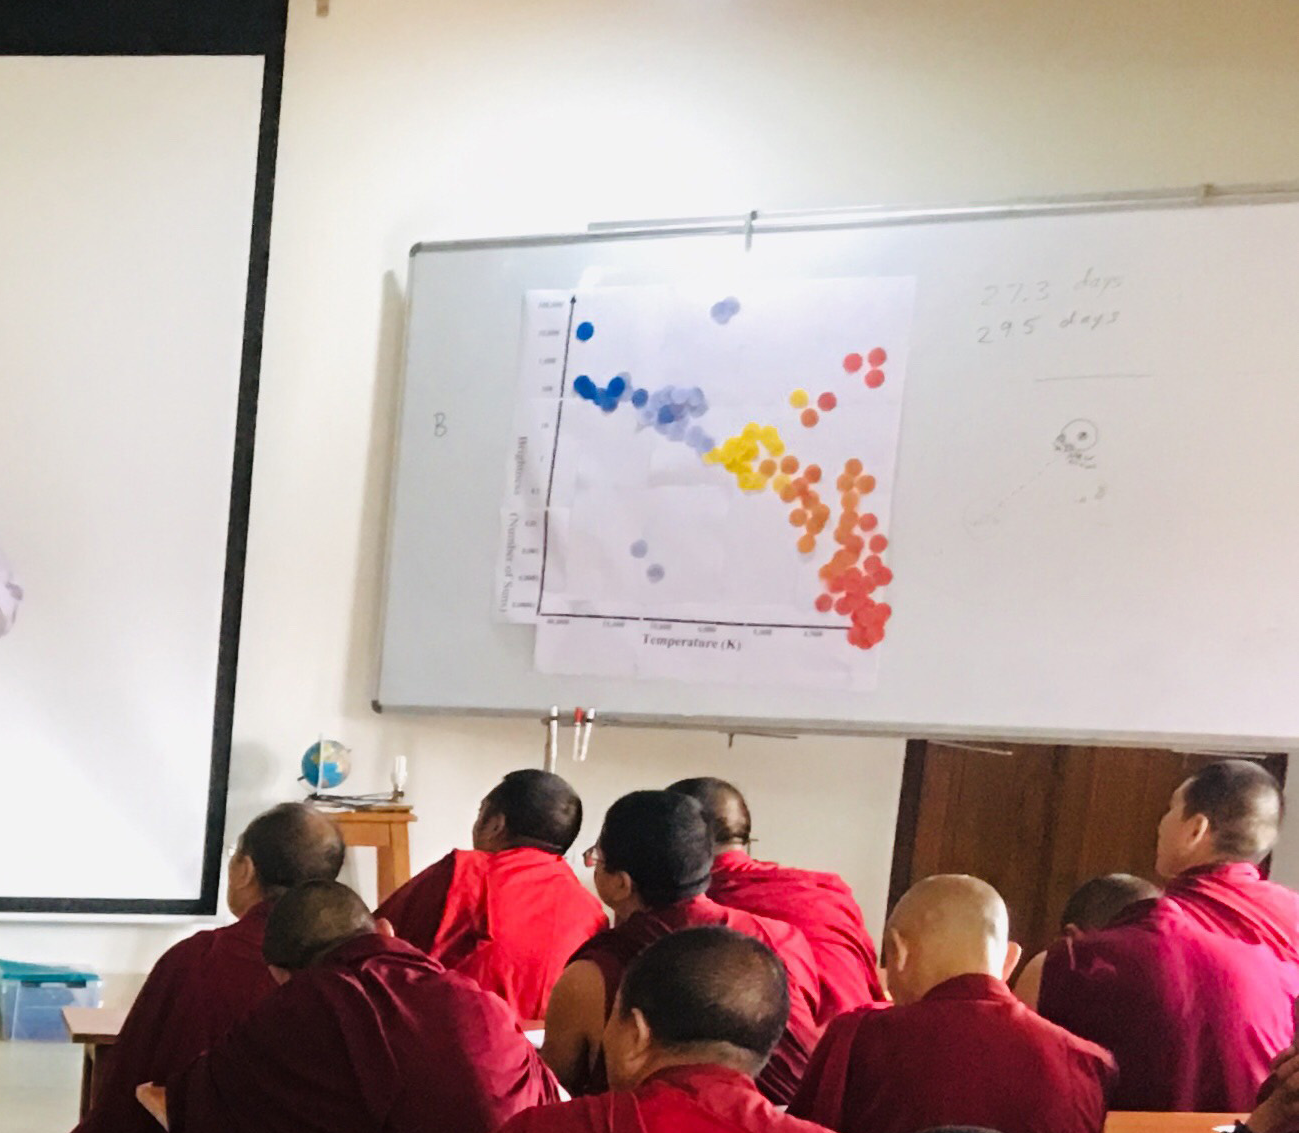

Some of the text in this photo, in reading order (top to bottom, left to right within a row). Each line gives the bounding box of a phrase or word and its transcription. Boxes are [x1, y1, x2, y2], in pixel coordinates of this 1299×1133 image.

[1058, 310, 1121, 331] days
[513, 436, 528, 496] Brightness
[504, 565, 514, 578] of
[642, 633, 742, 652] Temperature (K)
